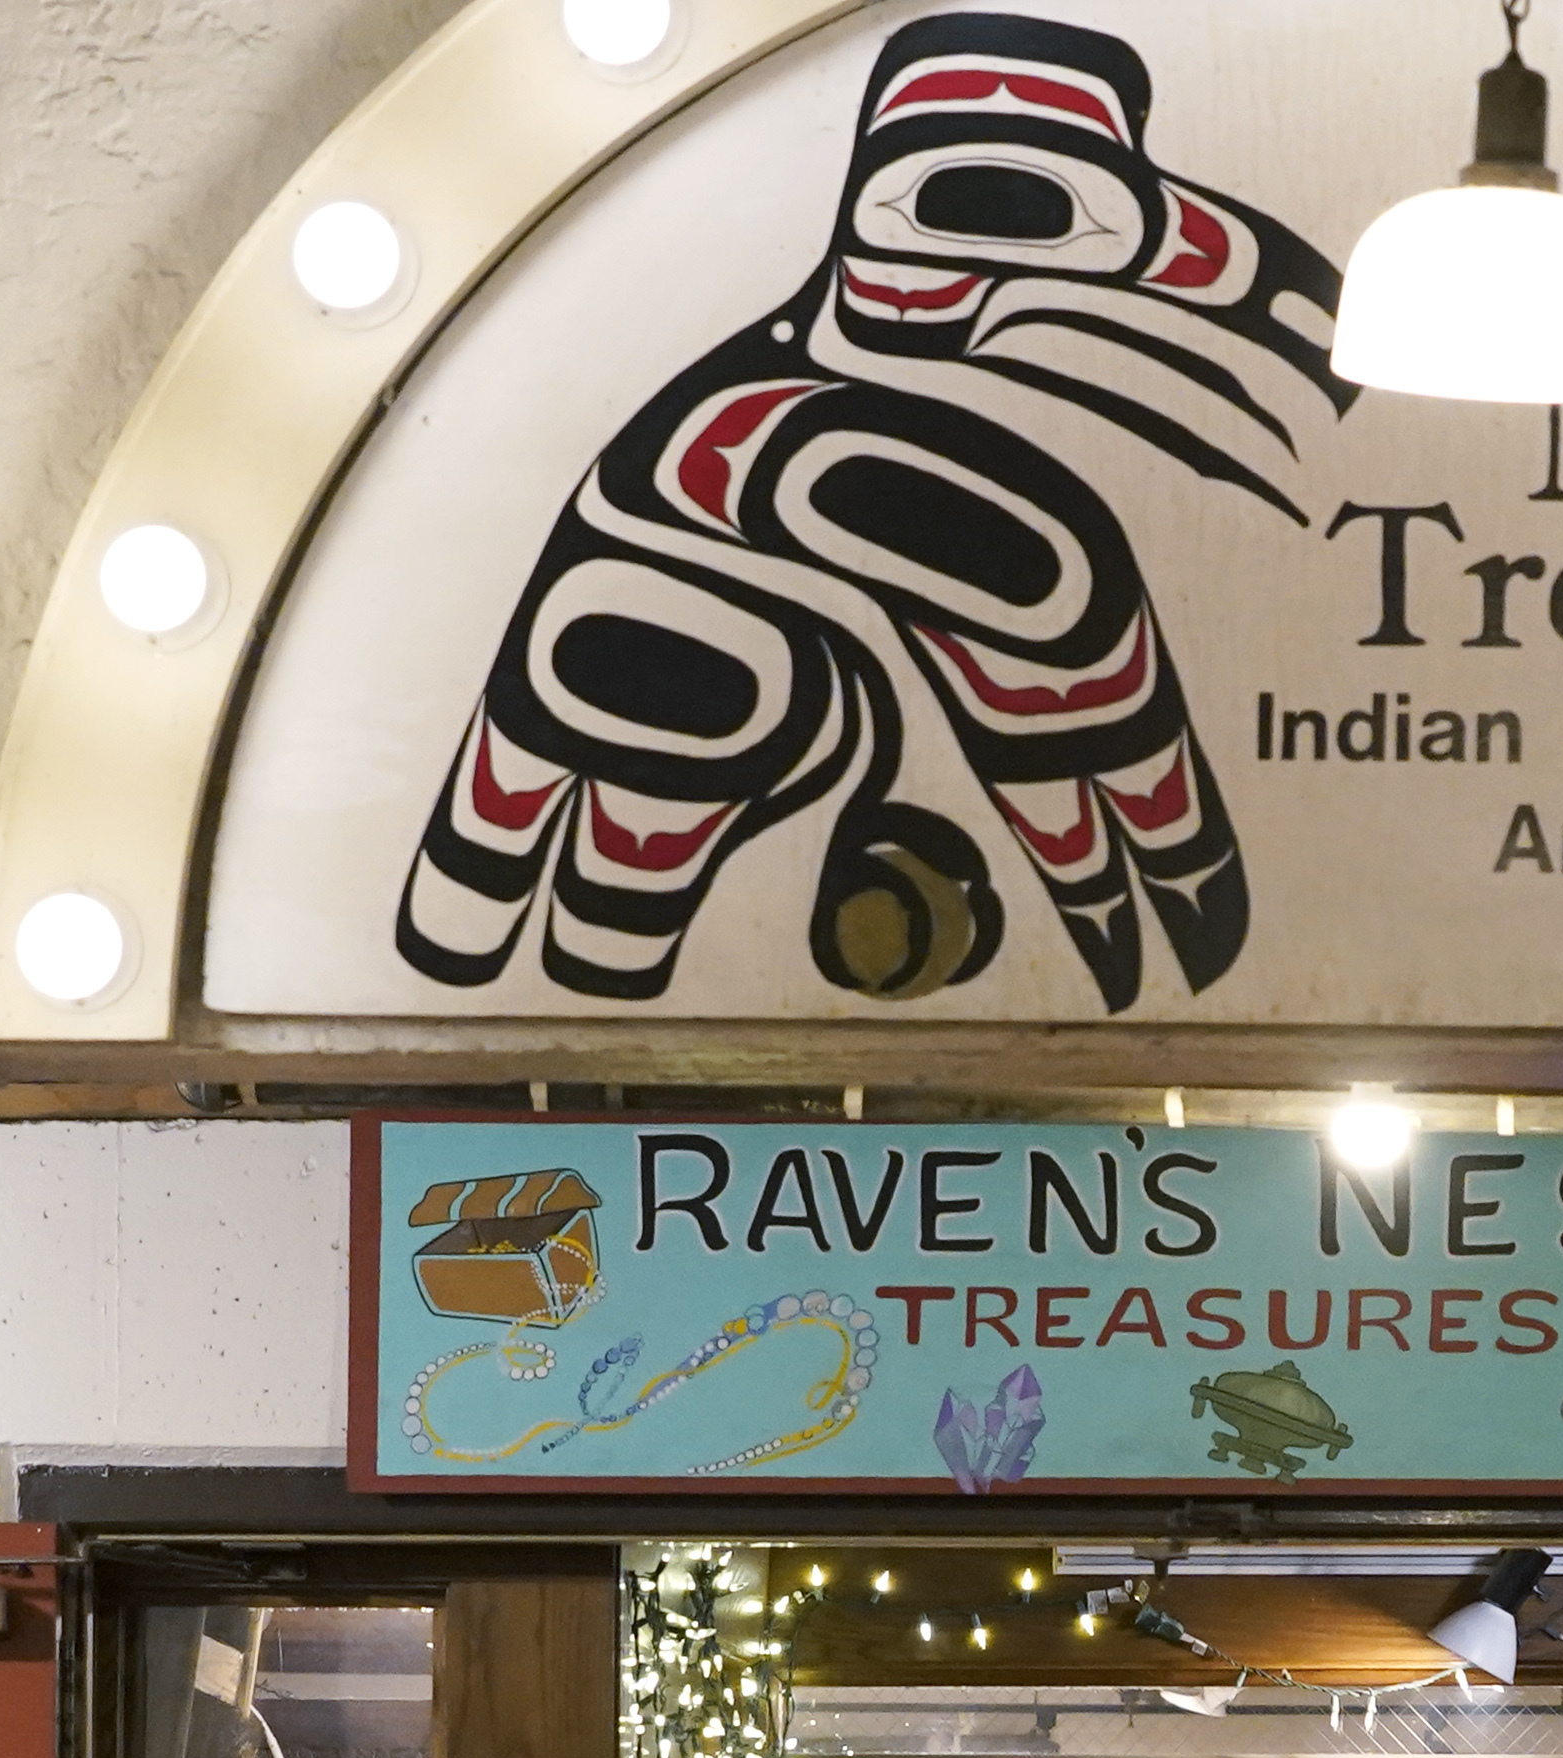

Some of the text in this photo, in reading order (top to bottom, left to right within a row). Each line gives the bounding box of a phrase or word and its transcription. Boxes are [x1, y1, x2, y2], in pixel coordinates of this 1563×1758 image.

[1255, 691, 1523, 765] Indian
[635, 1124, 1219, 1258] RAVEN'S
[874, 1285, 1559, 1355] TREASURES
